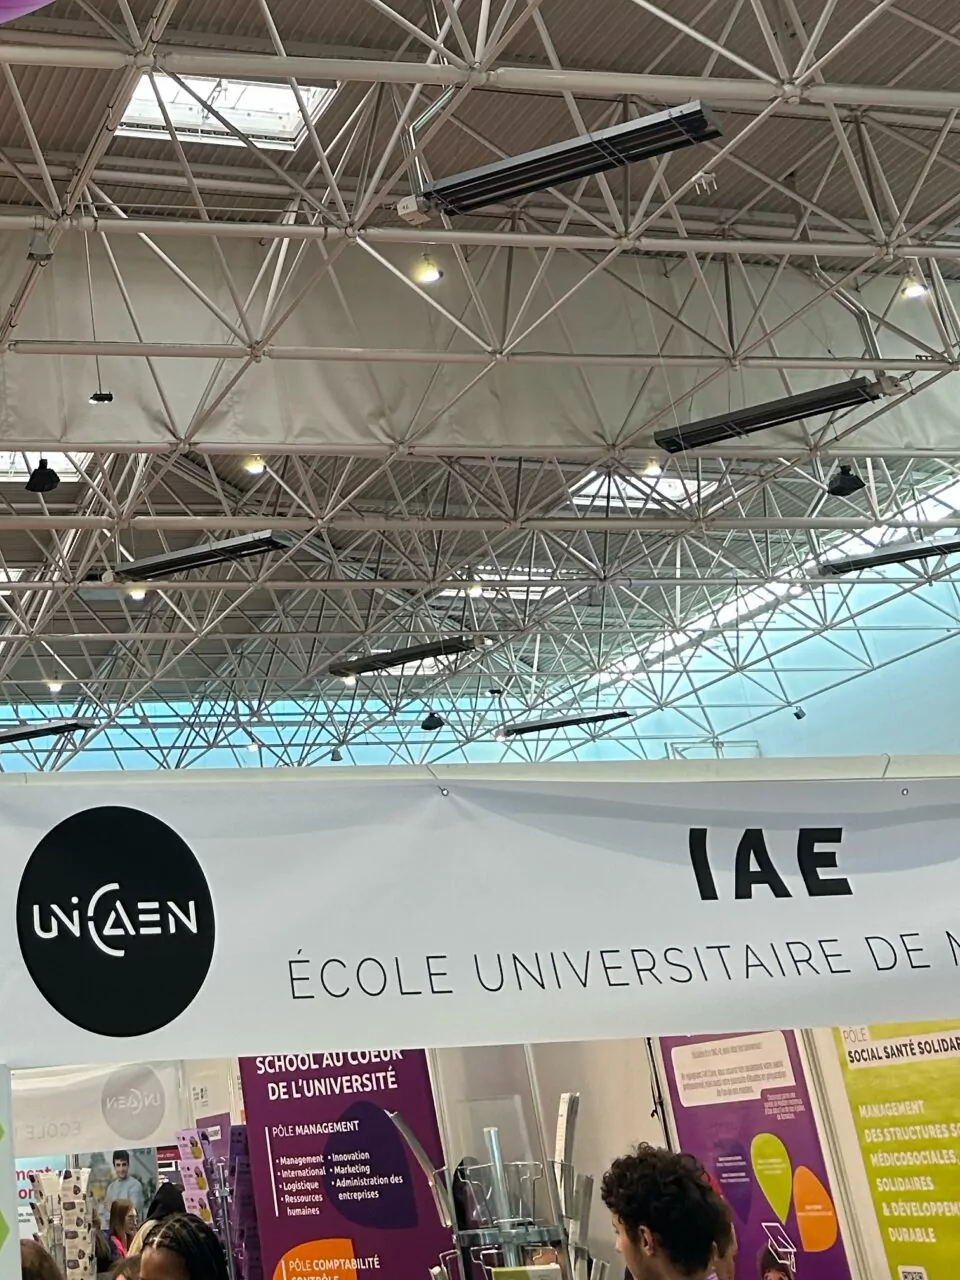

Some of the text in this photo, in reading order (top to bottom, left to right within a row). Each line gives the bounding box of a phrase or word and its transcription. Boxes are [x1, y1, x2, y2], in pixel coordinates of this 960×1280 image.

[689, 827, 854, 901] IAE
[289, 948, 454, 1000] ÉCOLE
[475, 937, 851, 993] UNIVERSITAIRE
[864, 931, 931, 971] DE
[843, 1027, 867, 1043] PÔLE
[848, 1046, 883, 1064] SOCIAL
[884, 1039, 916, 1060] SANTÉ
[256, 1049, 403, 1075] SCHOOL AU COEUR
[268, 1066, 398, 1101] DE L'UNIVERSITÉ
[859, 1100, 925, 1118] MANAGEMENT
[272, 1120, 360, 1137] PÔLE MANAGEMENT
[865, 1128, 883, 1143] DES
[883, 1124, 949, 1142] STRUCTURES
[280, 1154, 324, 1166] Management
[332, 1151, 370, 1161] Innovation
[281, 1166, 326, 1178] International
[334, 1165, 371, 1175] Marketing
[283, 1181, 319, 1192] Logistique
[336, 1175, 404, 1187] Administration des
[876, 1176, 935, 1192] SOLIDAIRES
[285, 1194, 323, 1203] Ressources
[339, 1191, 379, 1201] entreprises
[287, 1207, 320, 1217] humaines
[883, 1201, 890, 1216] &
[889, 1227, 937, 1243] DURABLE
[289, 1254, 380, 1271] PÔLE COMPTABILITÉ
